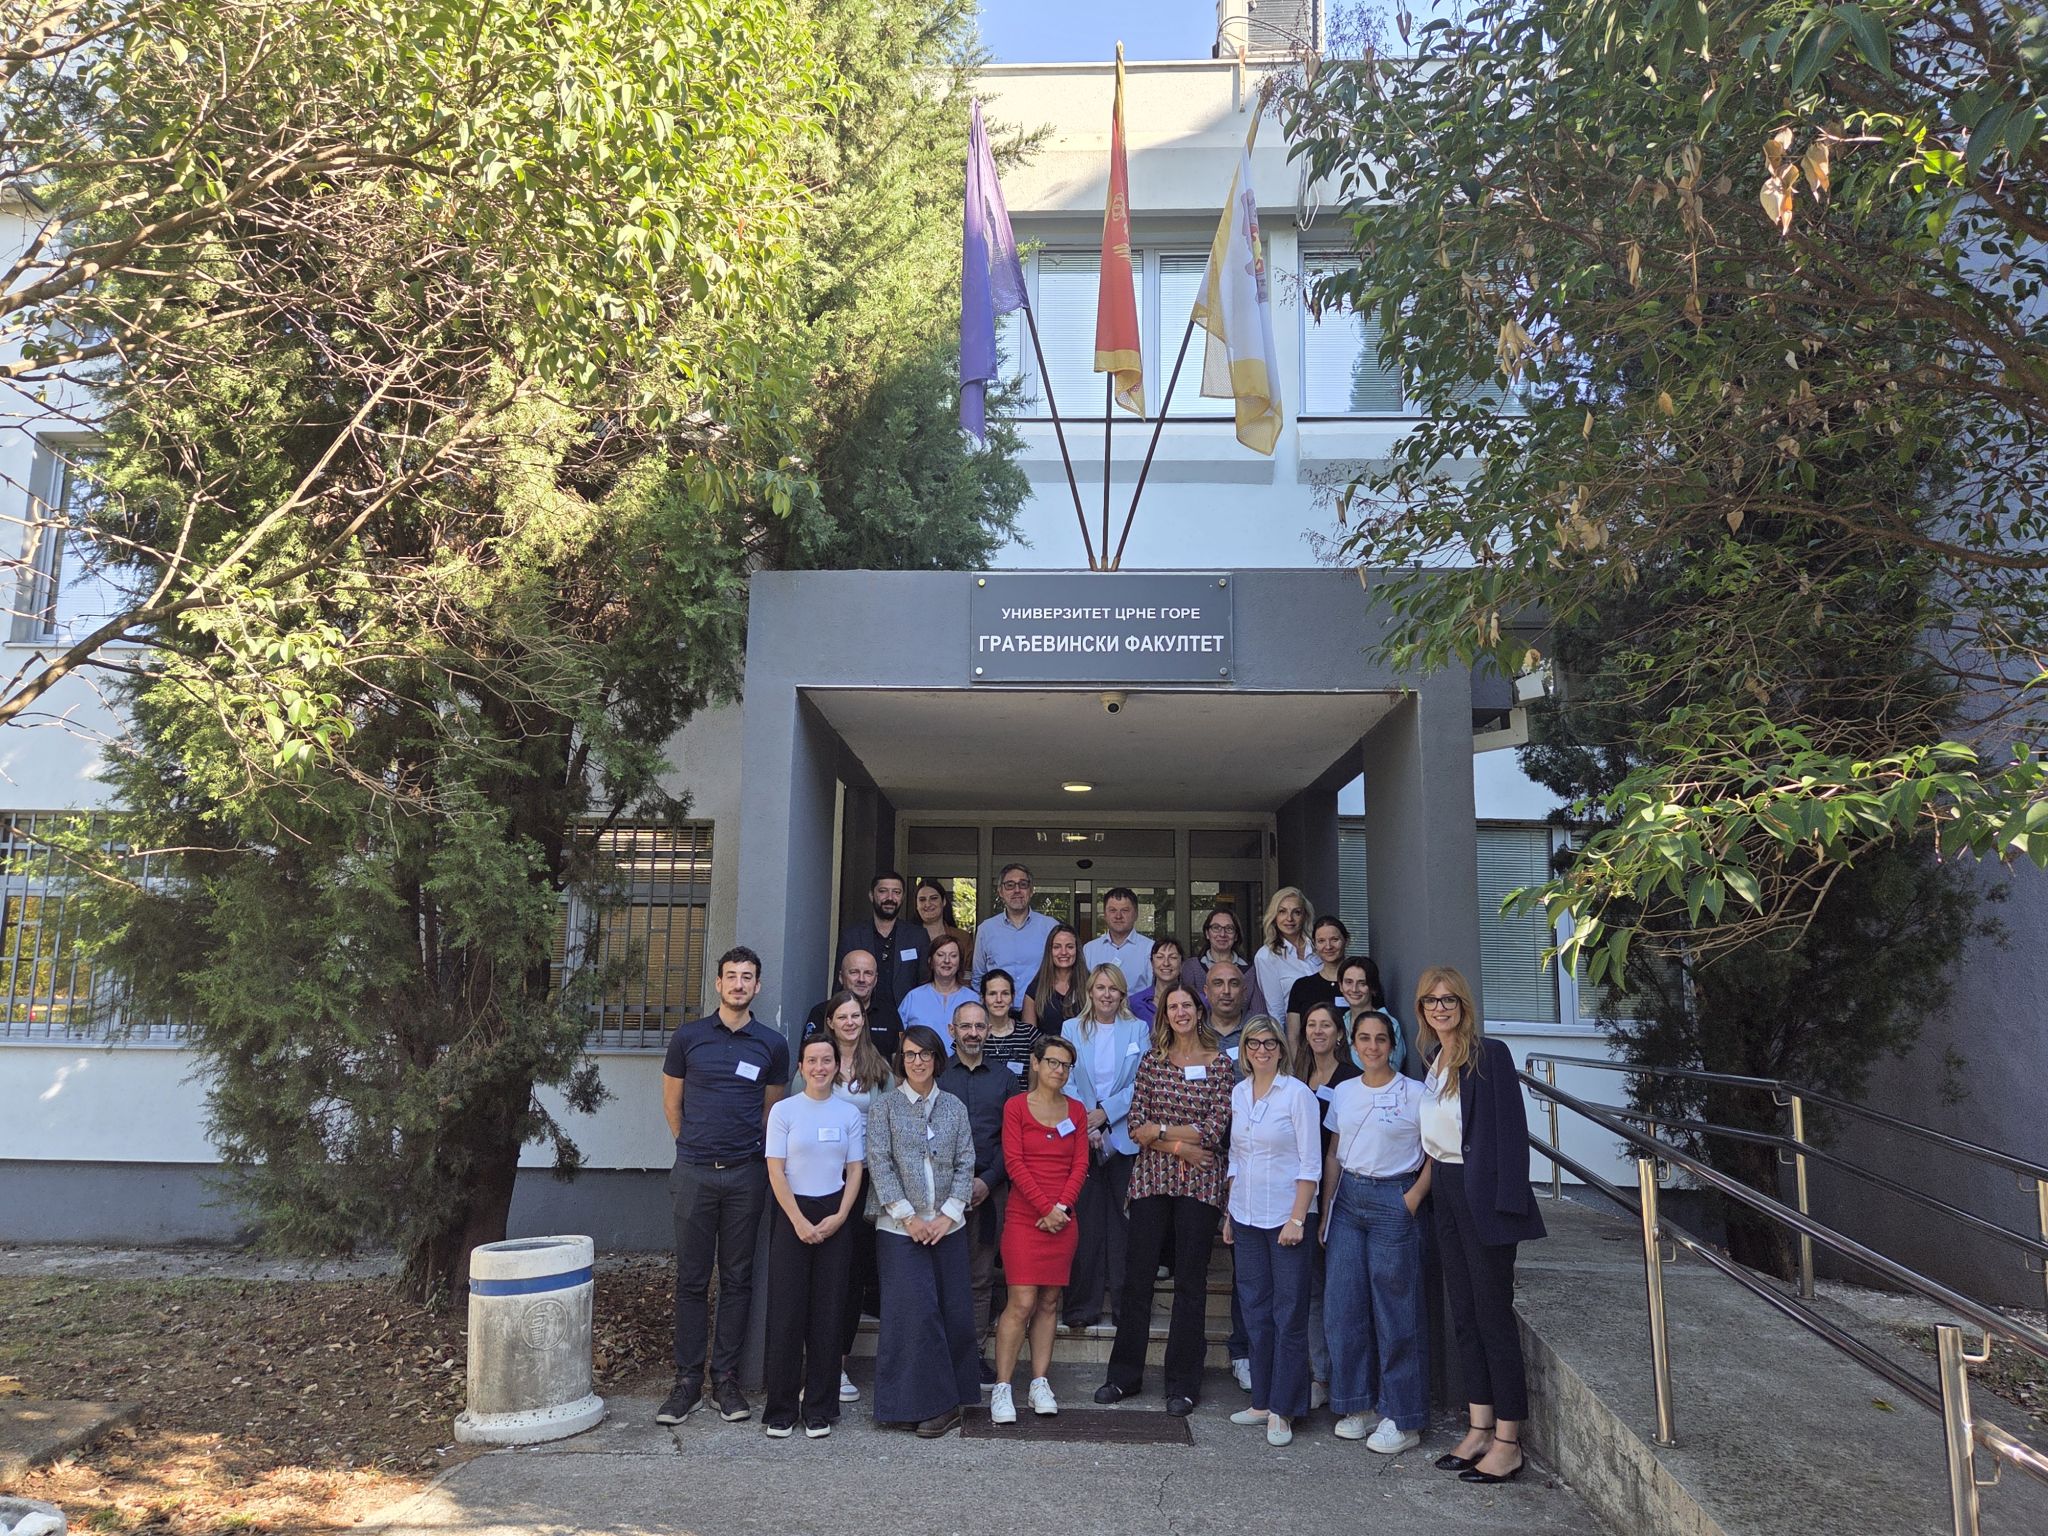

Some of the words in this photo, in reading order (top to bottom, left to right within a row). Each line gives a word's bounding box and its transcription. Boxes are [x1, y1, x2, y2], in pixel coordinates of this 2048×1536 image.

[1001, 607, 1111, 620] УНИВЕРЗИТЕТ
[1115, 607, 1156, 622] ЦРНЕ
[1161, 607, 1201, 620] ГОРЕ
[979, 635, 1119, 653] ГРАЂЕВИНСКИ
[1124, 634, 1225, 653] ФАКУЛТЕТ
